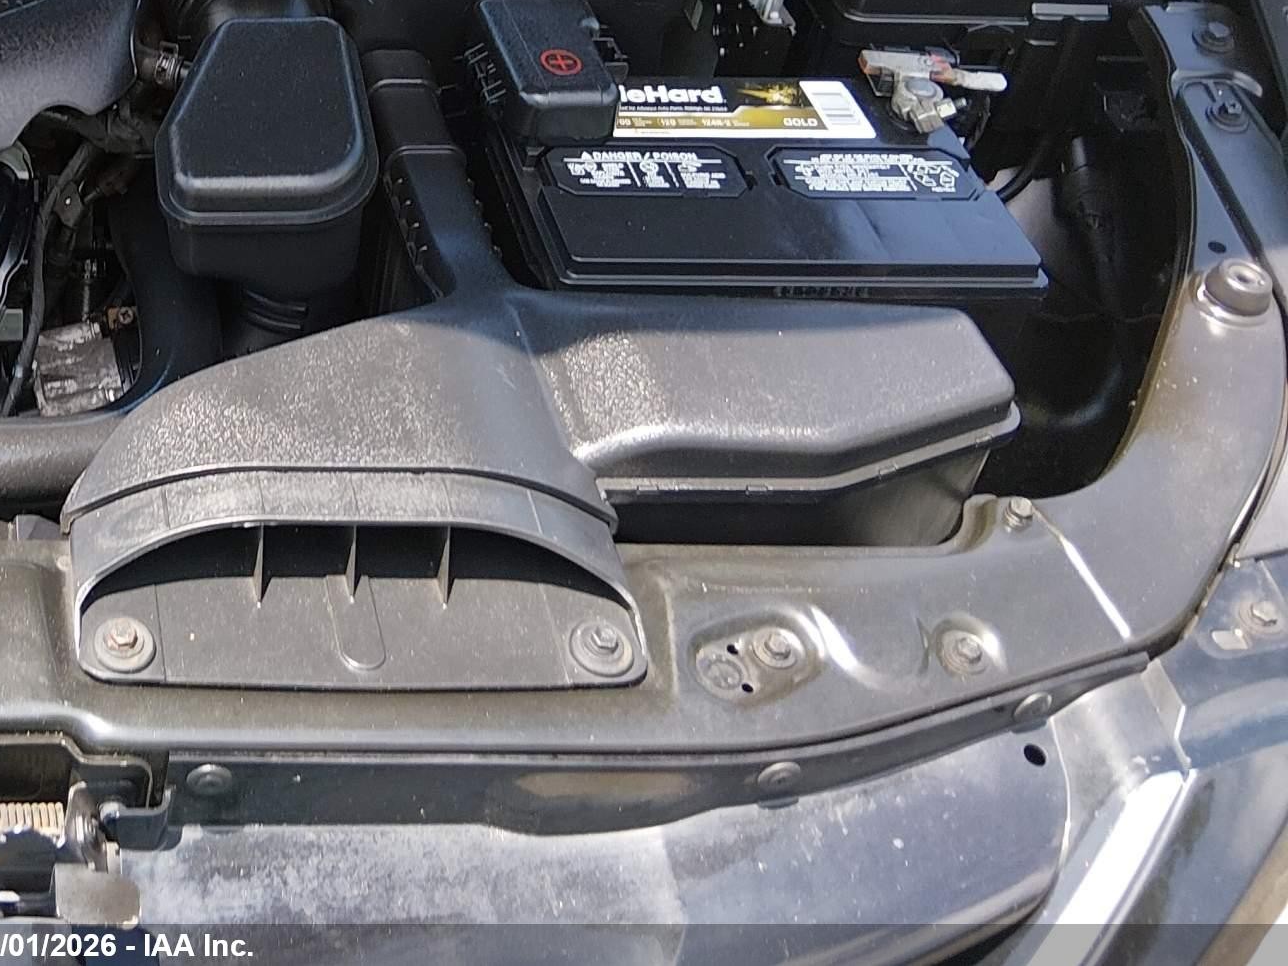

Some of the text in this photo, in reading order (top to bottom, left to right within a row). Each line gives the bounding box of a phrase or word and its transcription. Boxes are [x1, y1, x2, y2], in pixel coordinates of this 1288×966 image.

[618, 85, 724, 104] ieHard
[783, 117, 818, 126] GOLD
[593, 152, 642, 161] DANGER
[652, 152, 697, 162] POISON
